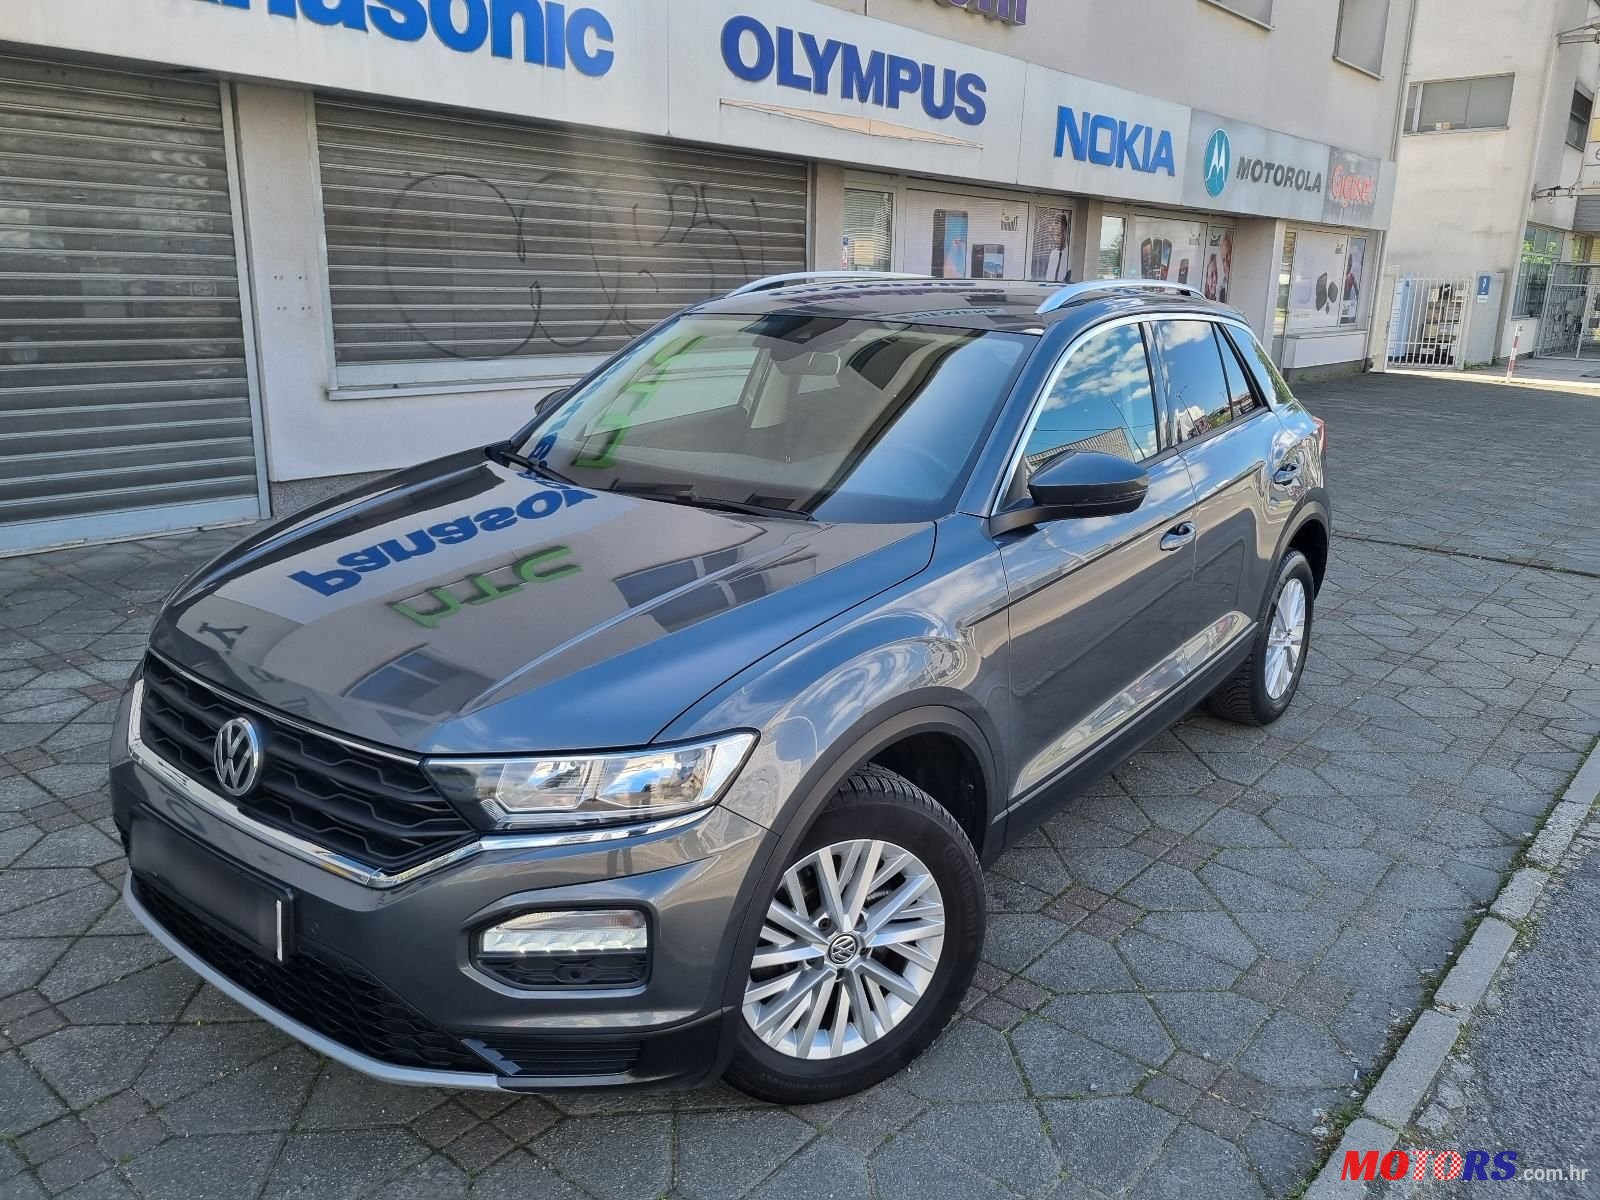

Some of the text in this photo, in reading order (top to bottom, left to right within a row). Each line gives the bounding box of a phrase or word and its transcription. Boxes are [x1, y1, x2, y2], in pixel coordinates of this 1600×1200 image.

[720, 15, 987, 126] OLYMPUS
[1053, 105, 1175, 177] NOKIA
[1236, 156, 1322, 193] MOTOROLA
